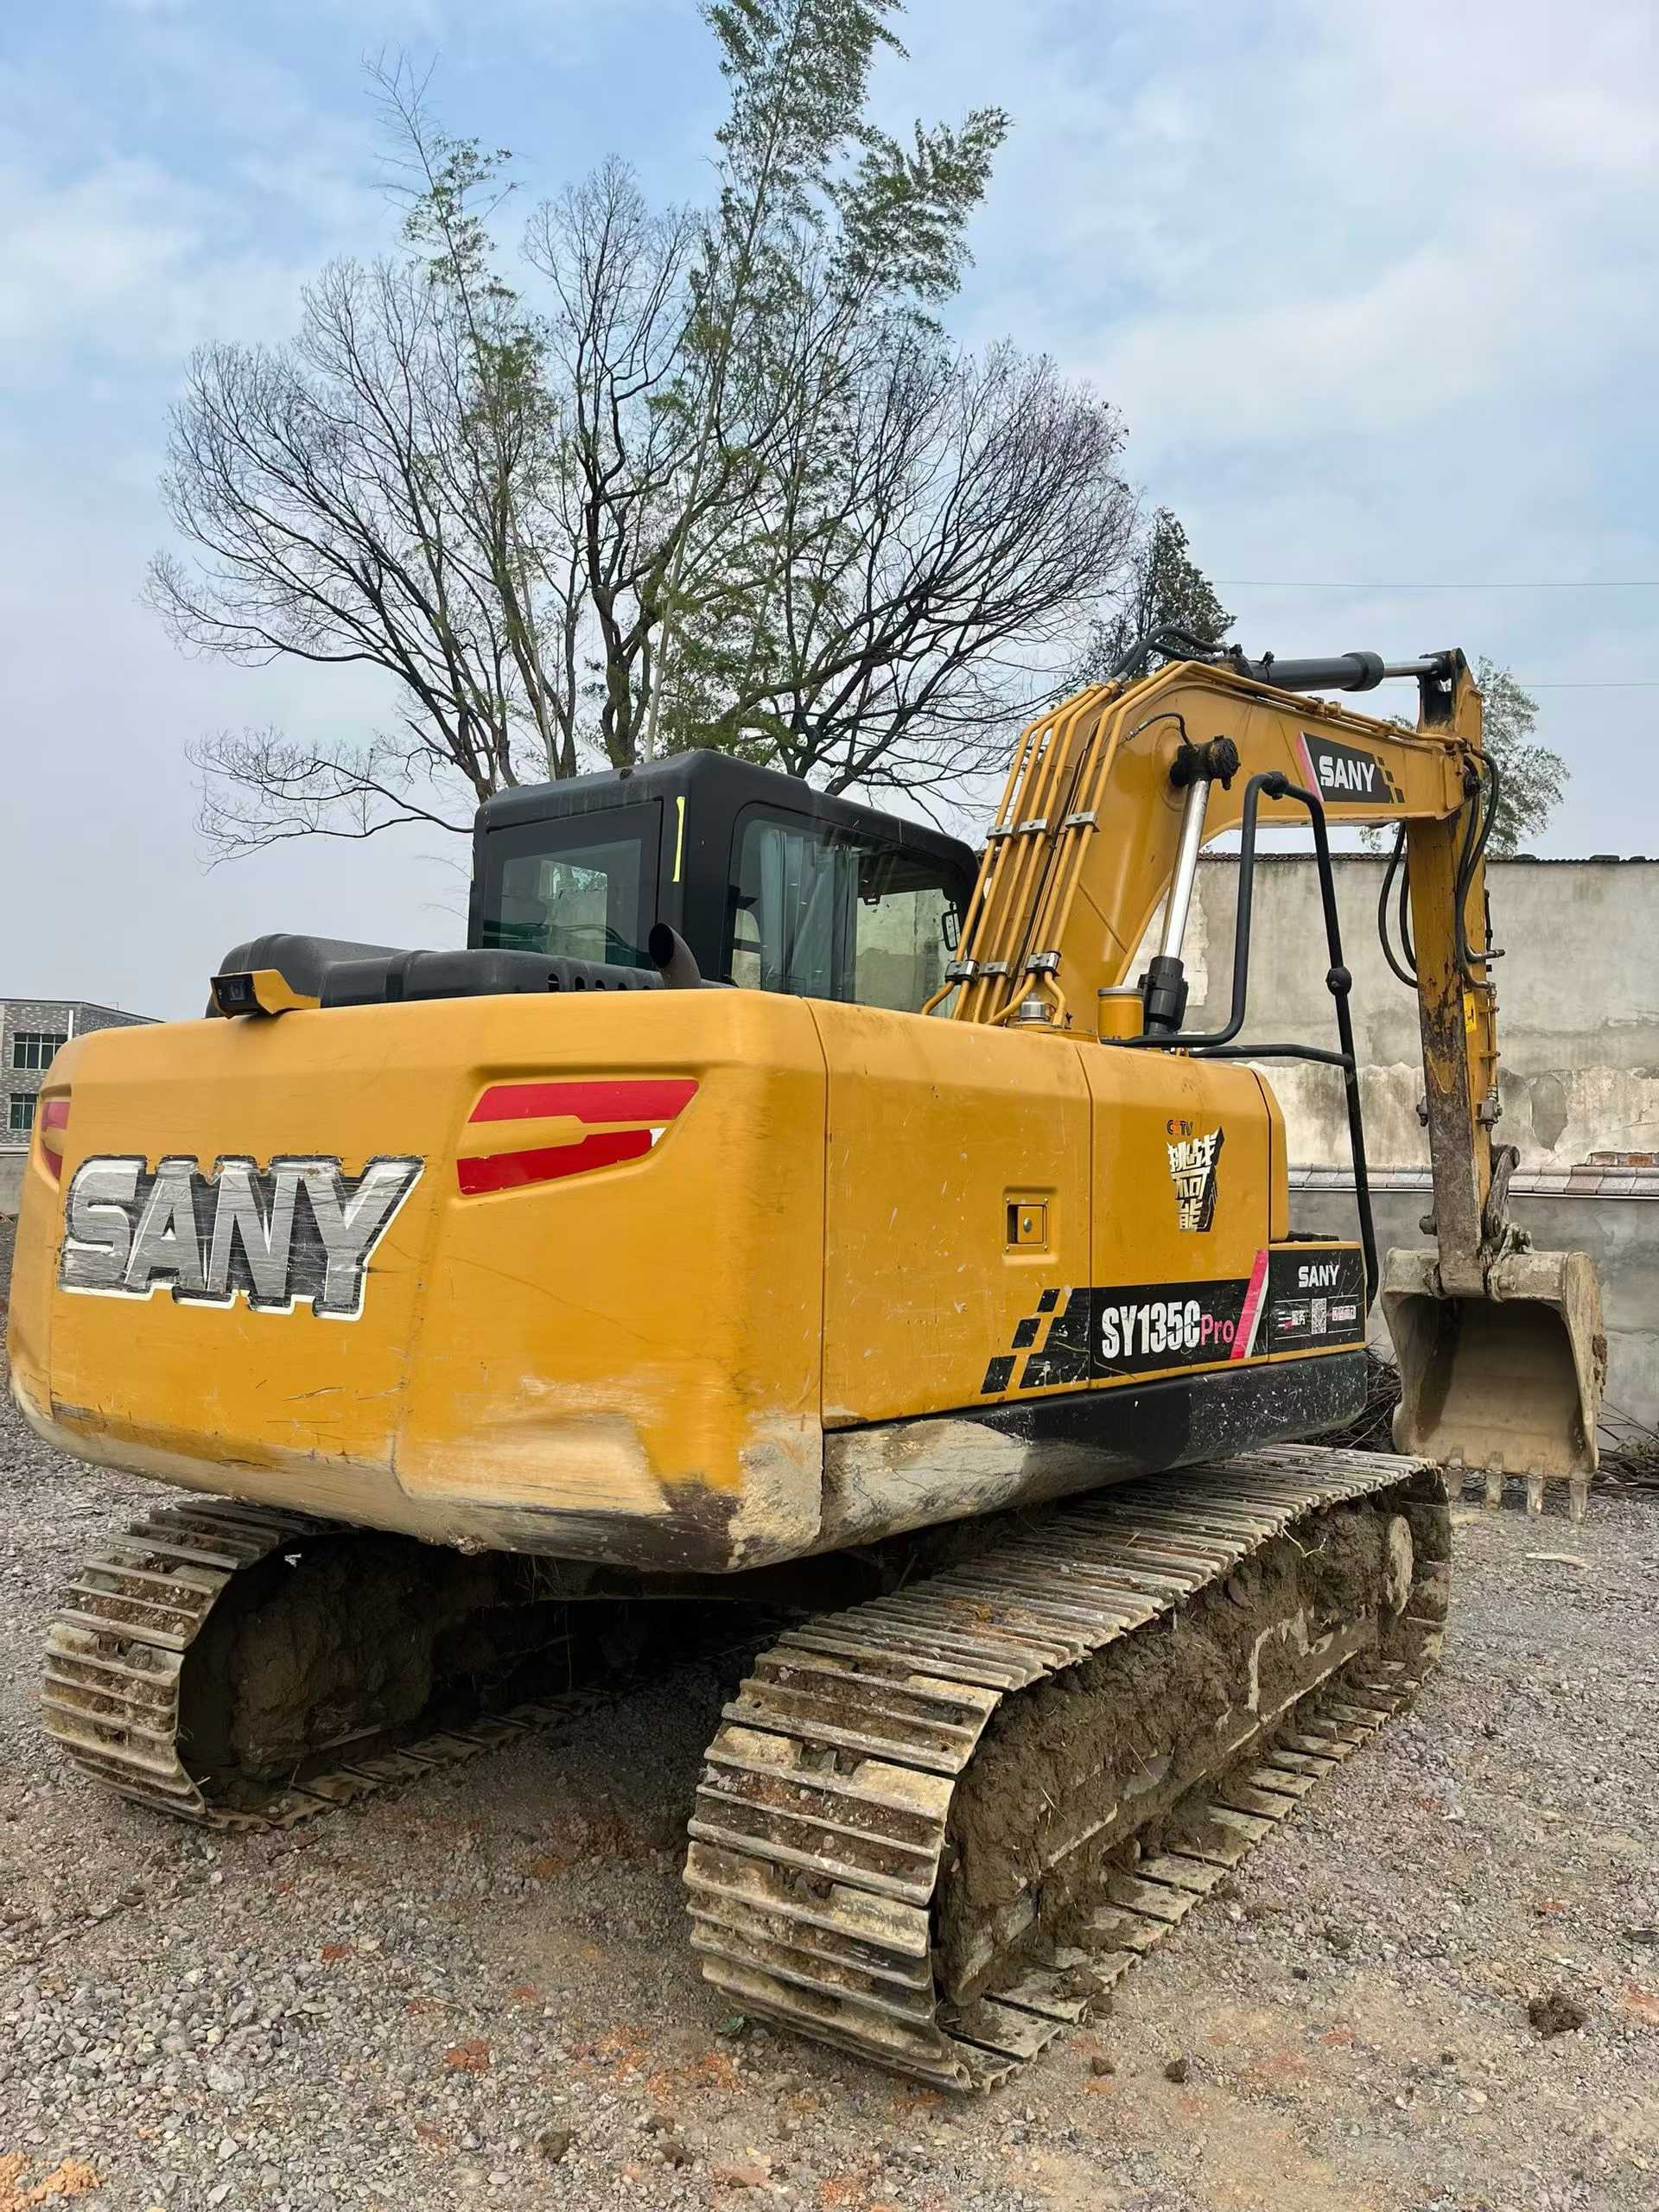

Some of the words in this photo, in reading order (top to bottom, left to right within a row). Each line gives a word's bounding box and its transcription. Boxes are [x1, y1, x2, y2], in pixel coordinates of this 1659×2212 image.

[1319, 755, 1376, 792] SANY
[59, 1156, 425, 1320] SANY
[1298, 1265, 1339, 1287] SANY
[1200, 1313, 1235, 1346] Pro
